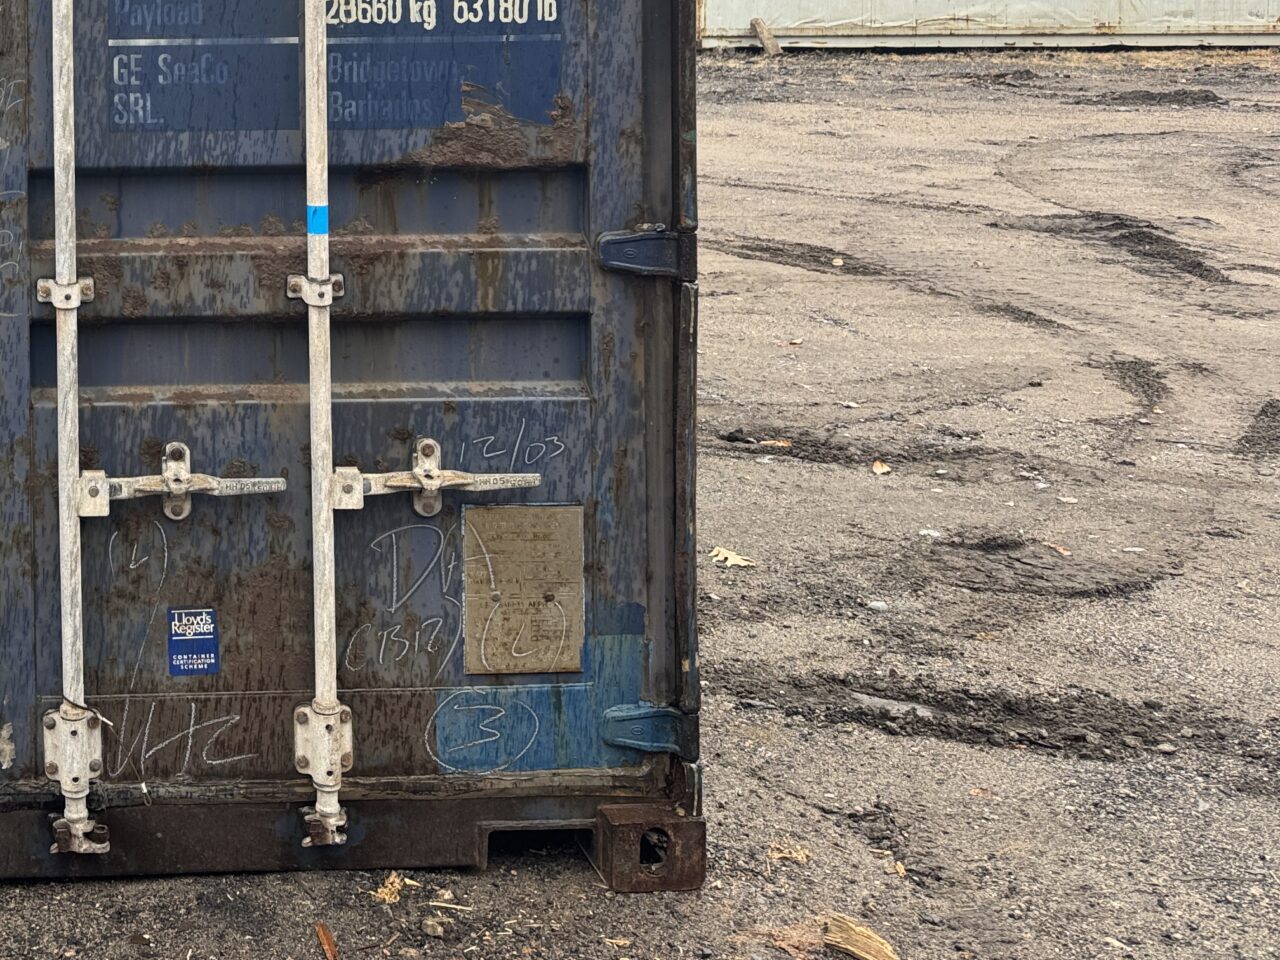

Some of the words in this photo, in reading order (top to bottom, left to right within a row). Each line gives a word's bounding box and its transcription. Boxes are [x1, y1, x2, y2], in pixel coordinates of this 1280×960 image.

[113, 54, 143, 86] GE
[113, 93, 165, 125] SRL.
[171, 622, 215, 637] Register
